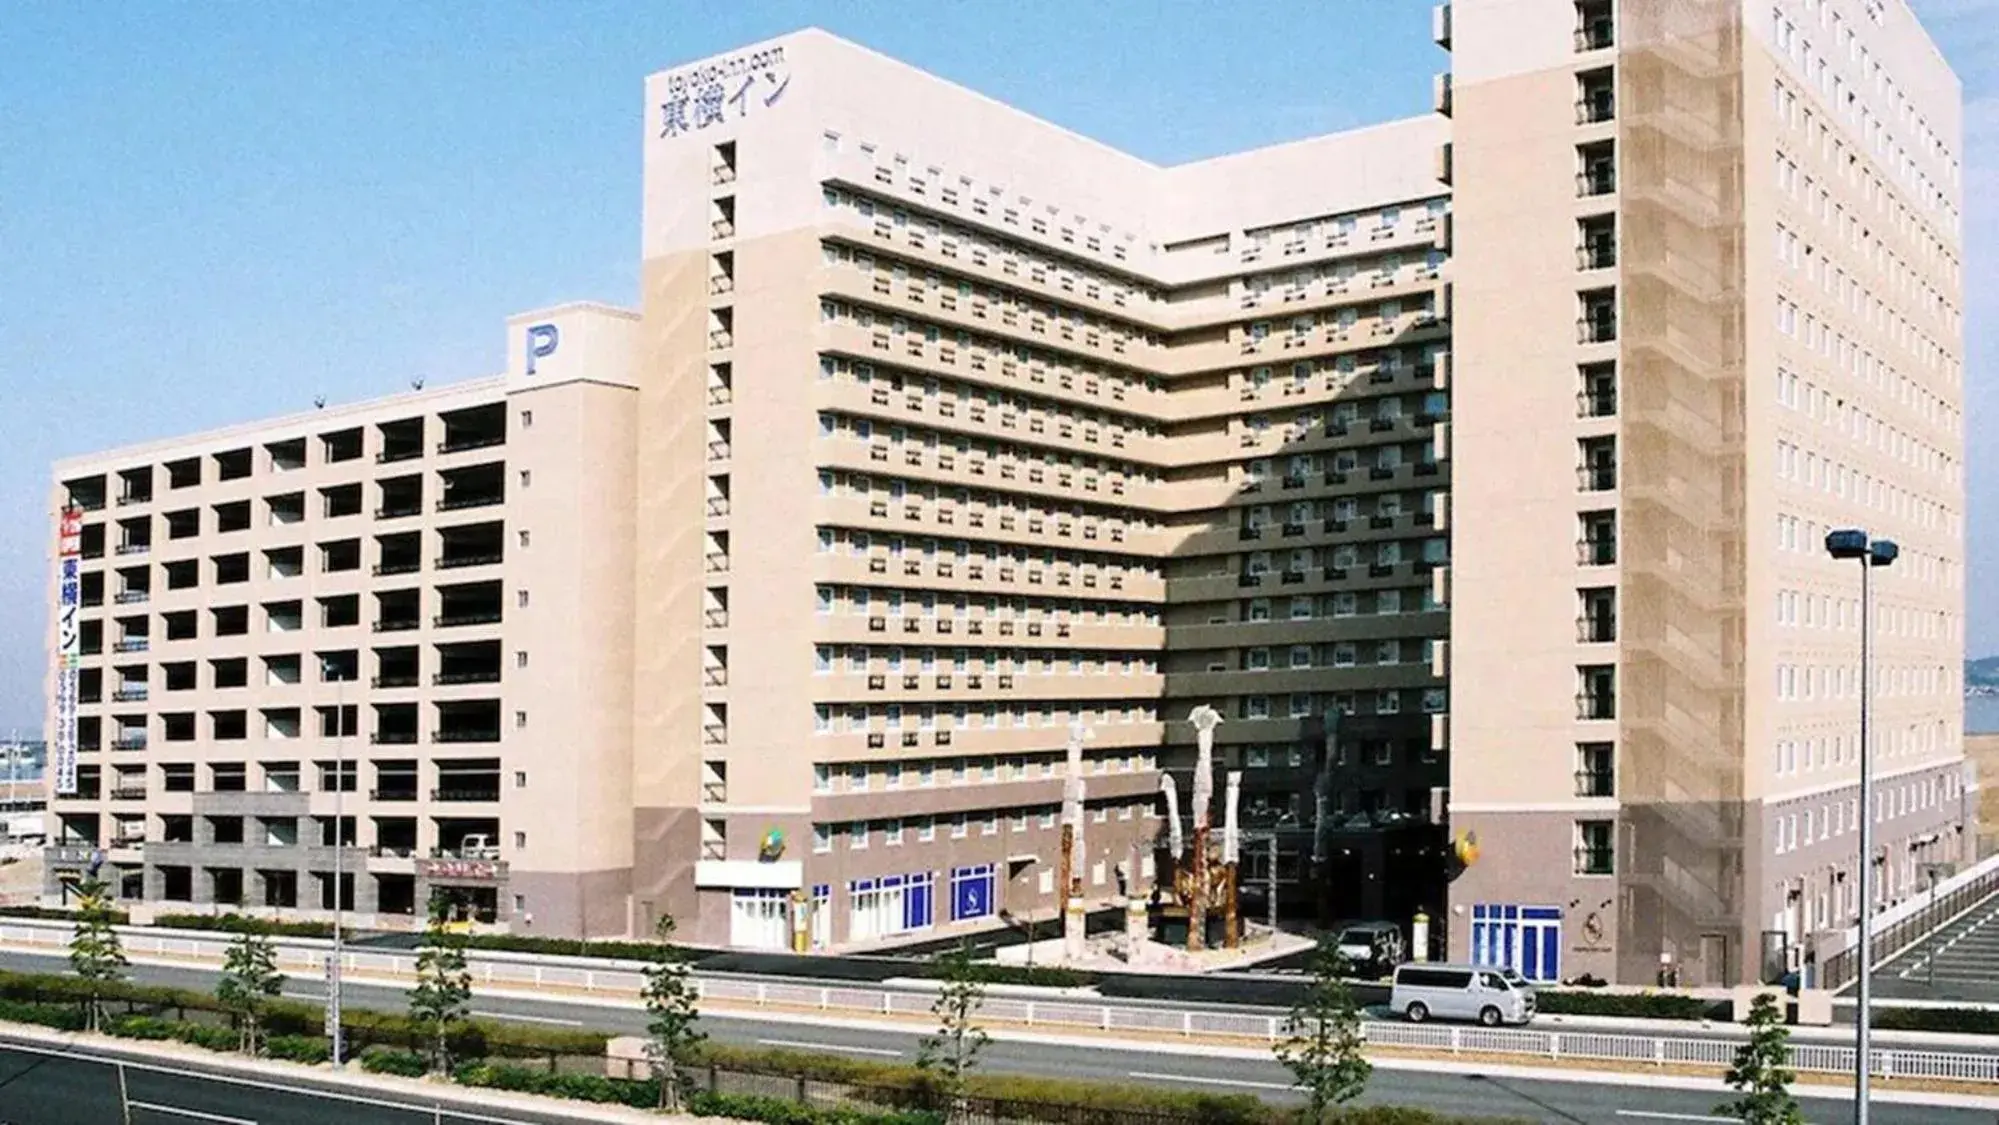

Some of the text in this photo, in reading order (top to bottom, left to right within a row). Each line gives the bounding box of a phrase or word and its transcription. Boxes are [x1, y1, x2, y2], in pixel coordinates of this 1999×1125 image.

[660, 74, 791, 138] 東横イン
[526, 323, 559, 376] P
[62, 558, 79, 649] 東横イン
